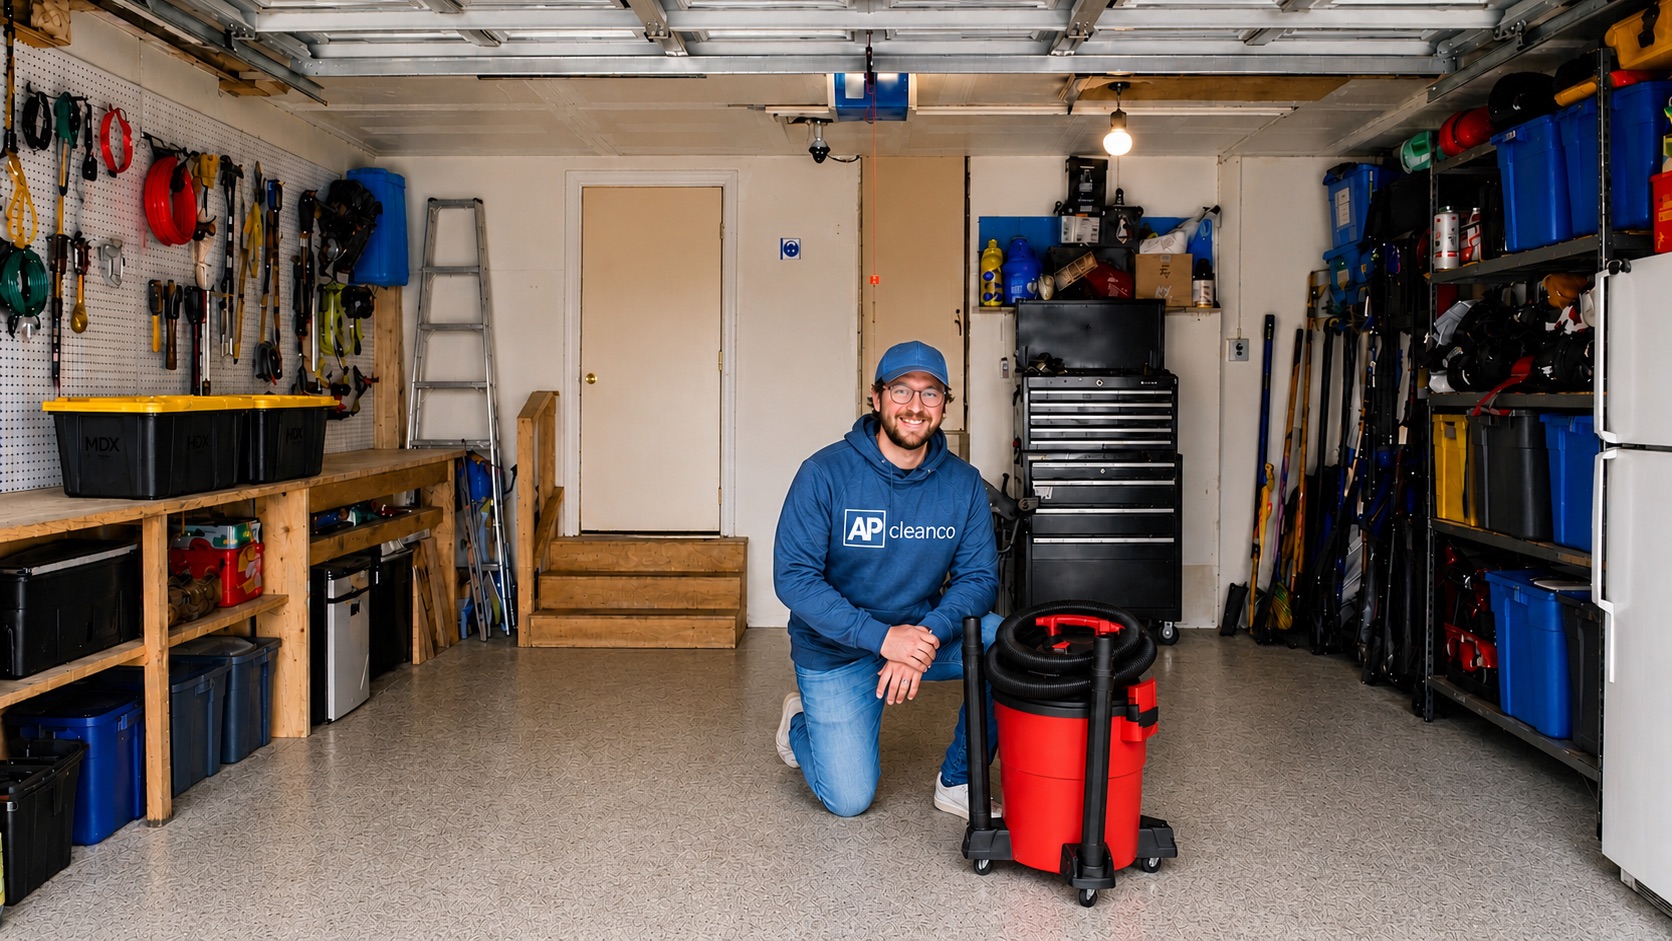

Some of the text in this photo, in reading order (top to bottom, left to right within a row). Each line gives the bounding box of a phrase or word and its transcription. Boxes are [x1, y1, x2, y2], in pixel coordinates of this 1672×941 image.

[85, 436, 120, 452] MDX
[847, 516, 956, 541] AP cleanco
